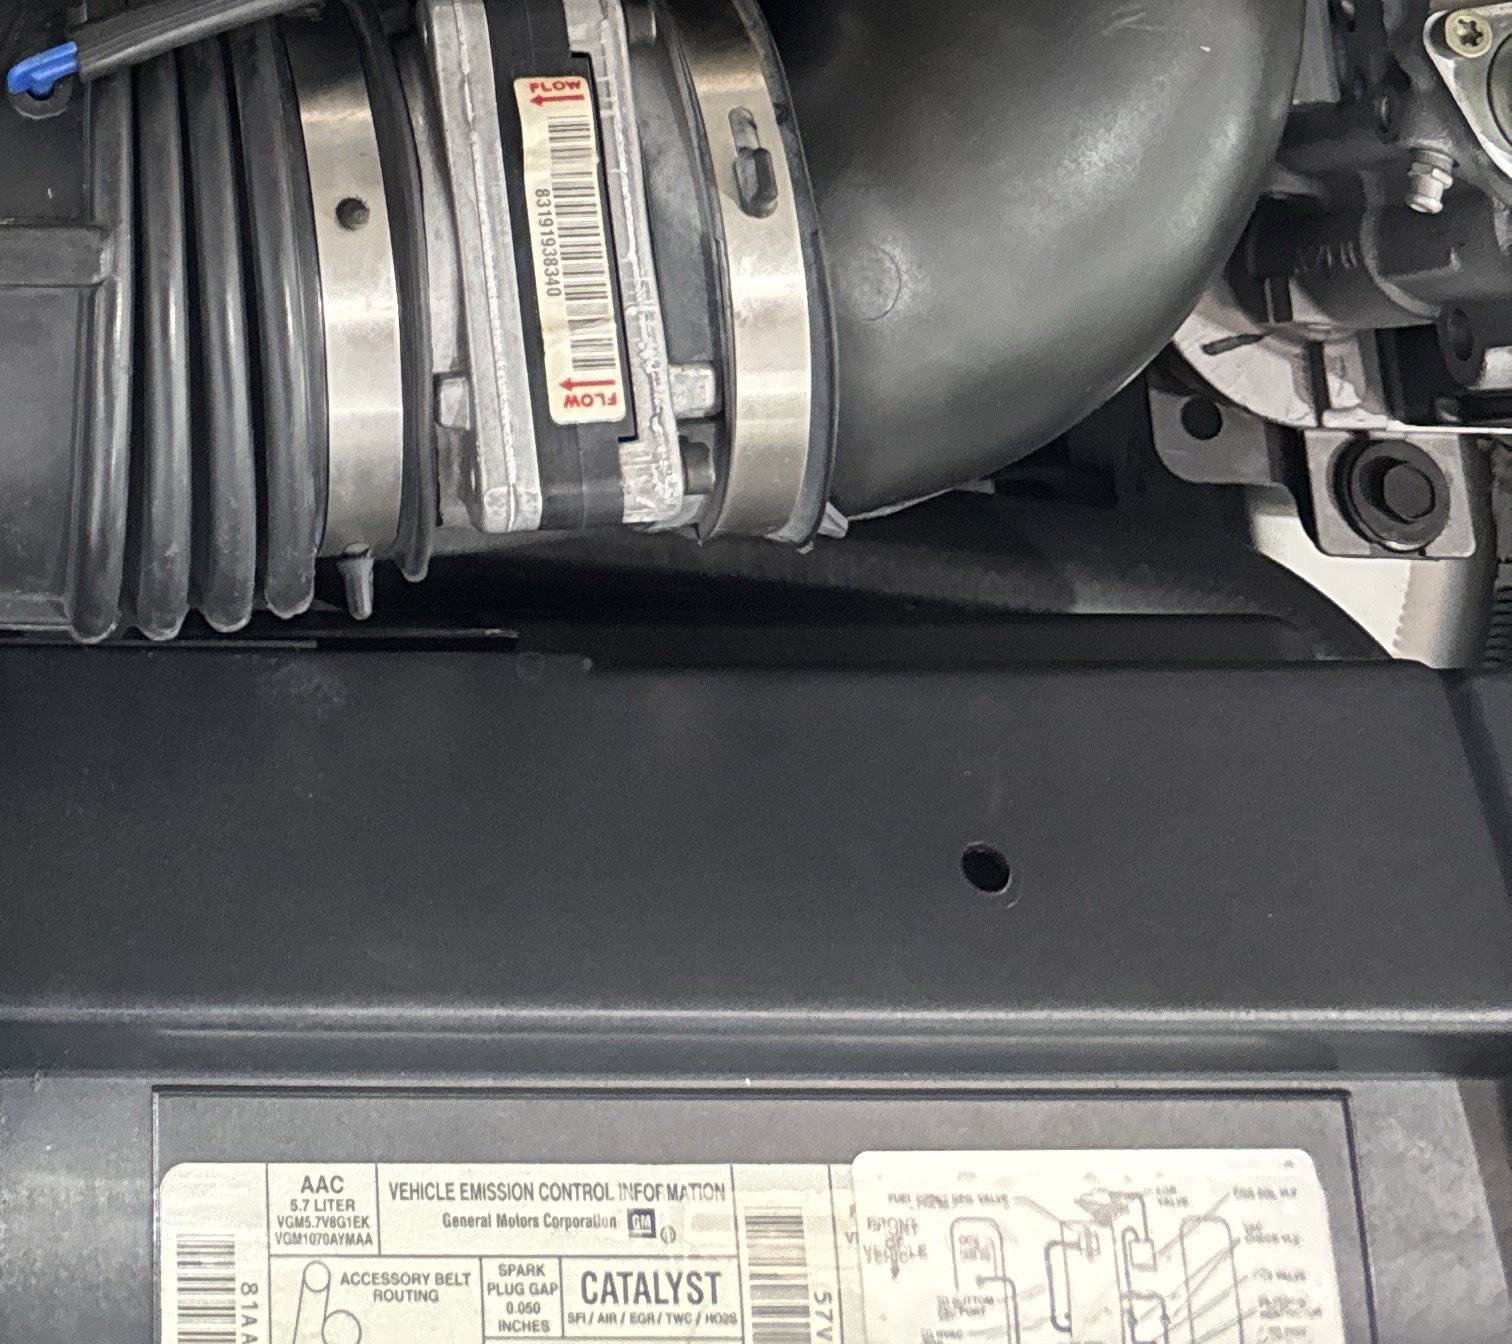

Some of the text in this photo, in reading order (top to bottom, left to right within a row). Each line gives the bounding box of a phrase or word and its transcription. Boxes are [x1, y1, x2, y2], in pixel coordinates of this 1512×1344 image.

[529, 79, 582, 93] FLOW
[535, 188, 562, 297] 83191938340
[563, 391, 618, 410] FLOW
[300, 1174, 345, 1195] AAC
[388, 1181, 456, 1202] VEHICLE
[459, 1181, 535, 1202] EMISSION
[538, 1181, 616, 1202] CONTROL
[289, 1198, 356, 1213] 5.7 LITER
[442, 1212, 492, 1229] General
[495, 1212, 540, 1229] Motors
[542, 1211, 618, 1232] Corporation
[498, 1263, 546, 1277] SPARK
[340, 1271, 472, 1287] ACCESSORY BELT
[372, 1288, 439, 1303] ROUTING
[487, 1281, 559, 1297] PLUG GAP
[580, 1270, 722, 1305] CATALYST
[498, 1318, 551, 1333] INCHES
[597, 1311, 617, 1325] AIR
